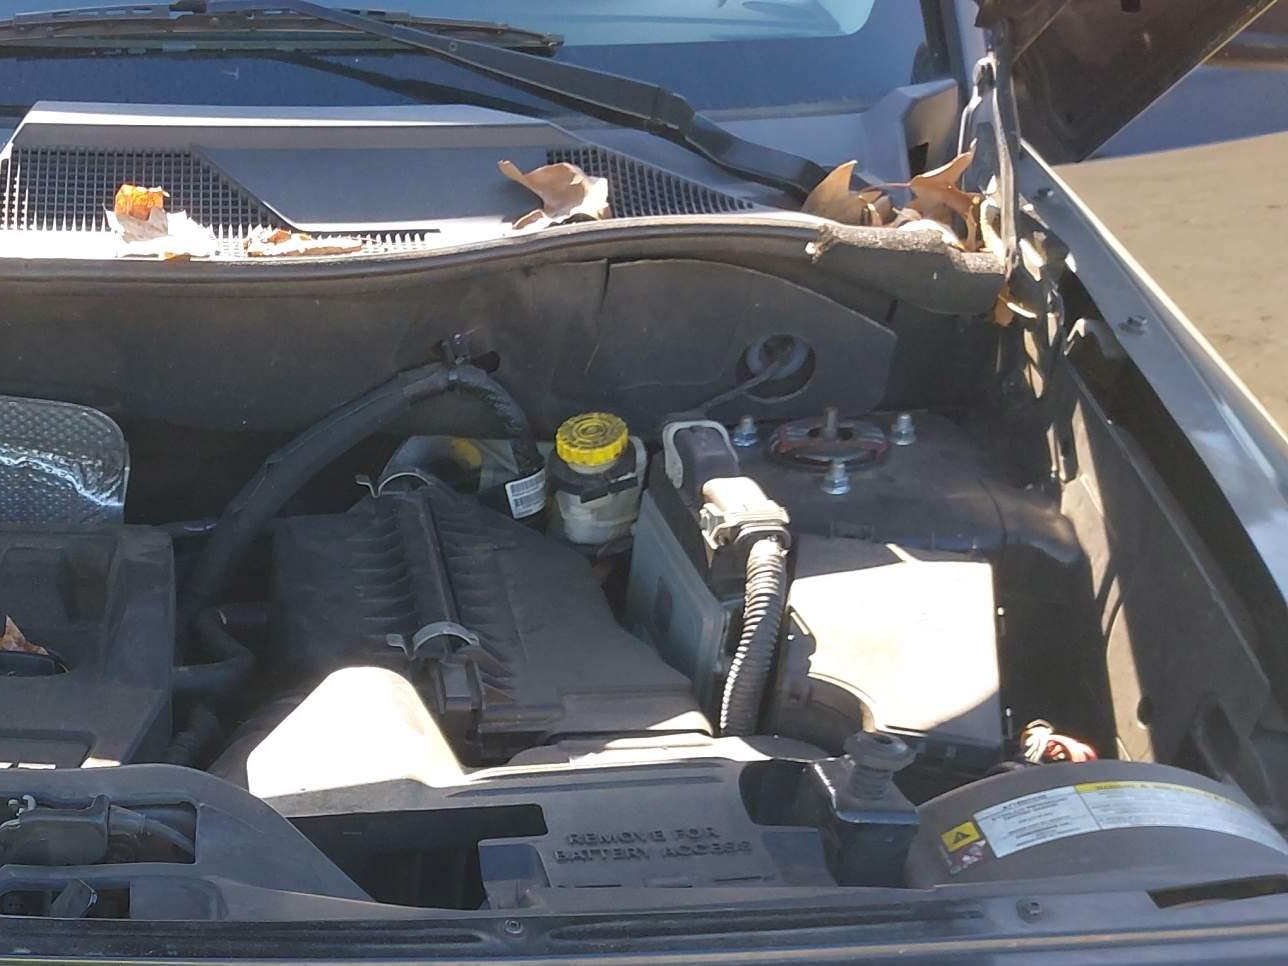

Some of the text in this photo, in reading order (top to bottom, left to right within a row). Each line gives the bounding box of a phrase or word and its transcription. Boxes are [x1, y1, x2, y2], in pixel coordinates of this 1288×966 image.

[567, 826, 720, 847] REMOVE FOR
[553, 840, 753, 865] BATTERY ACCESS
